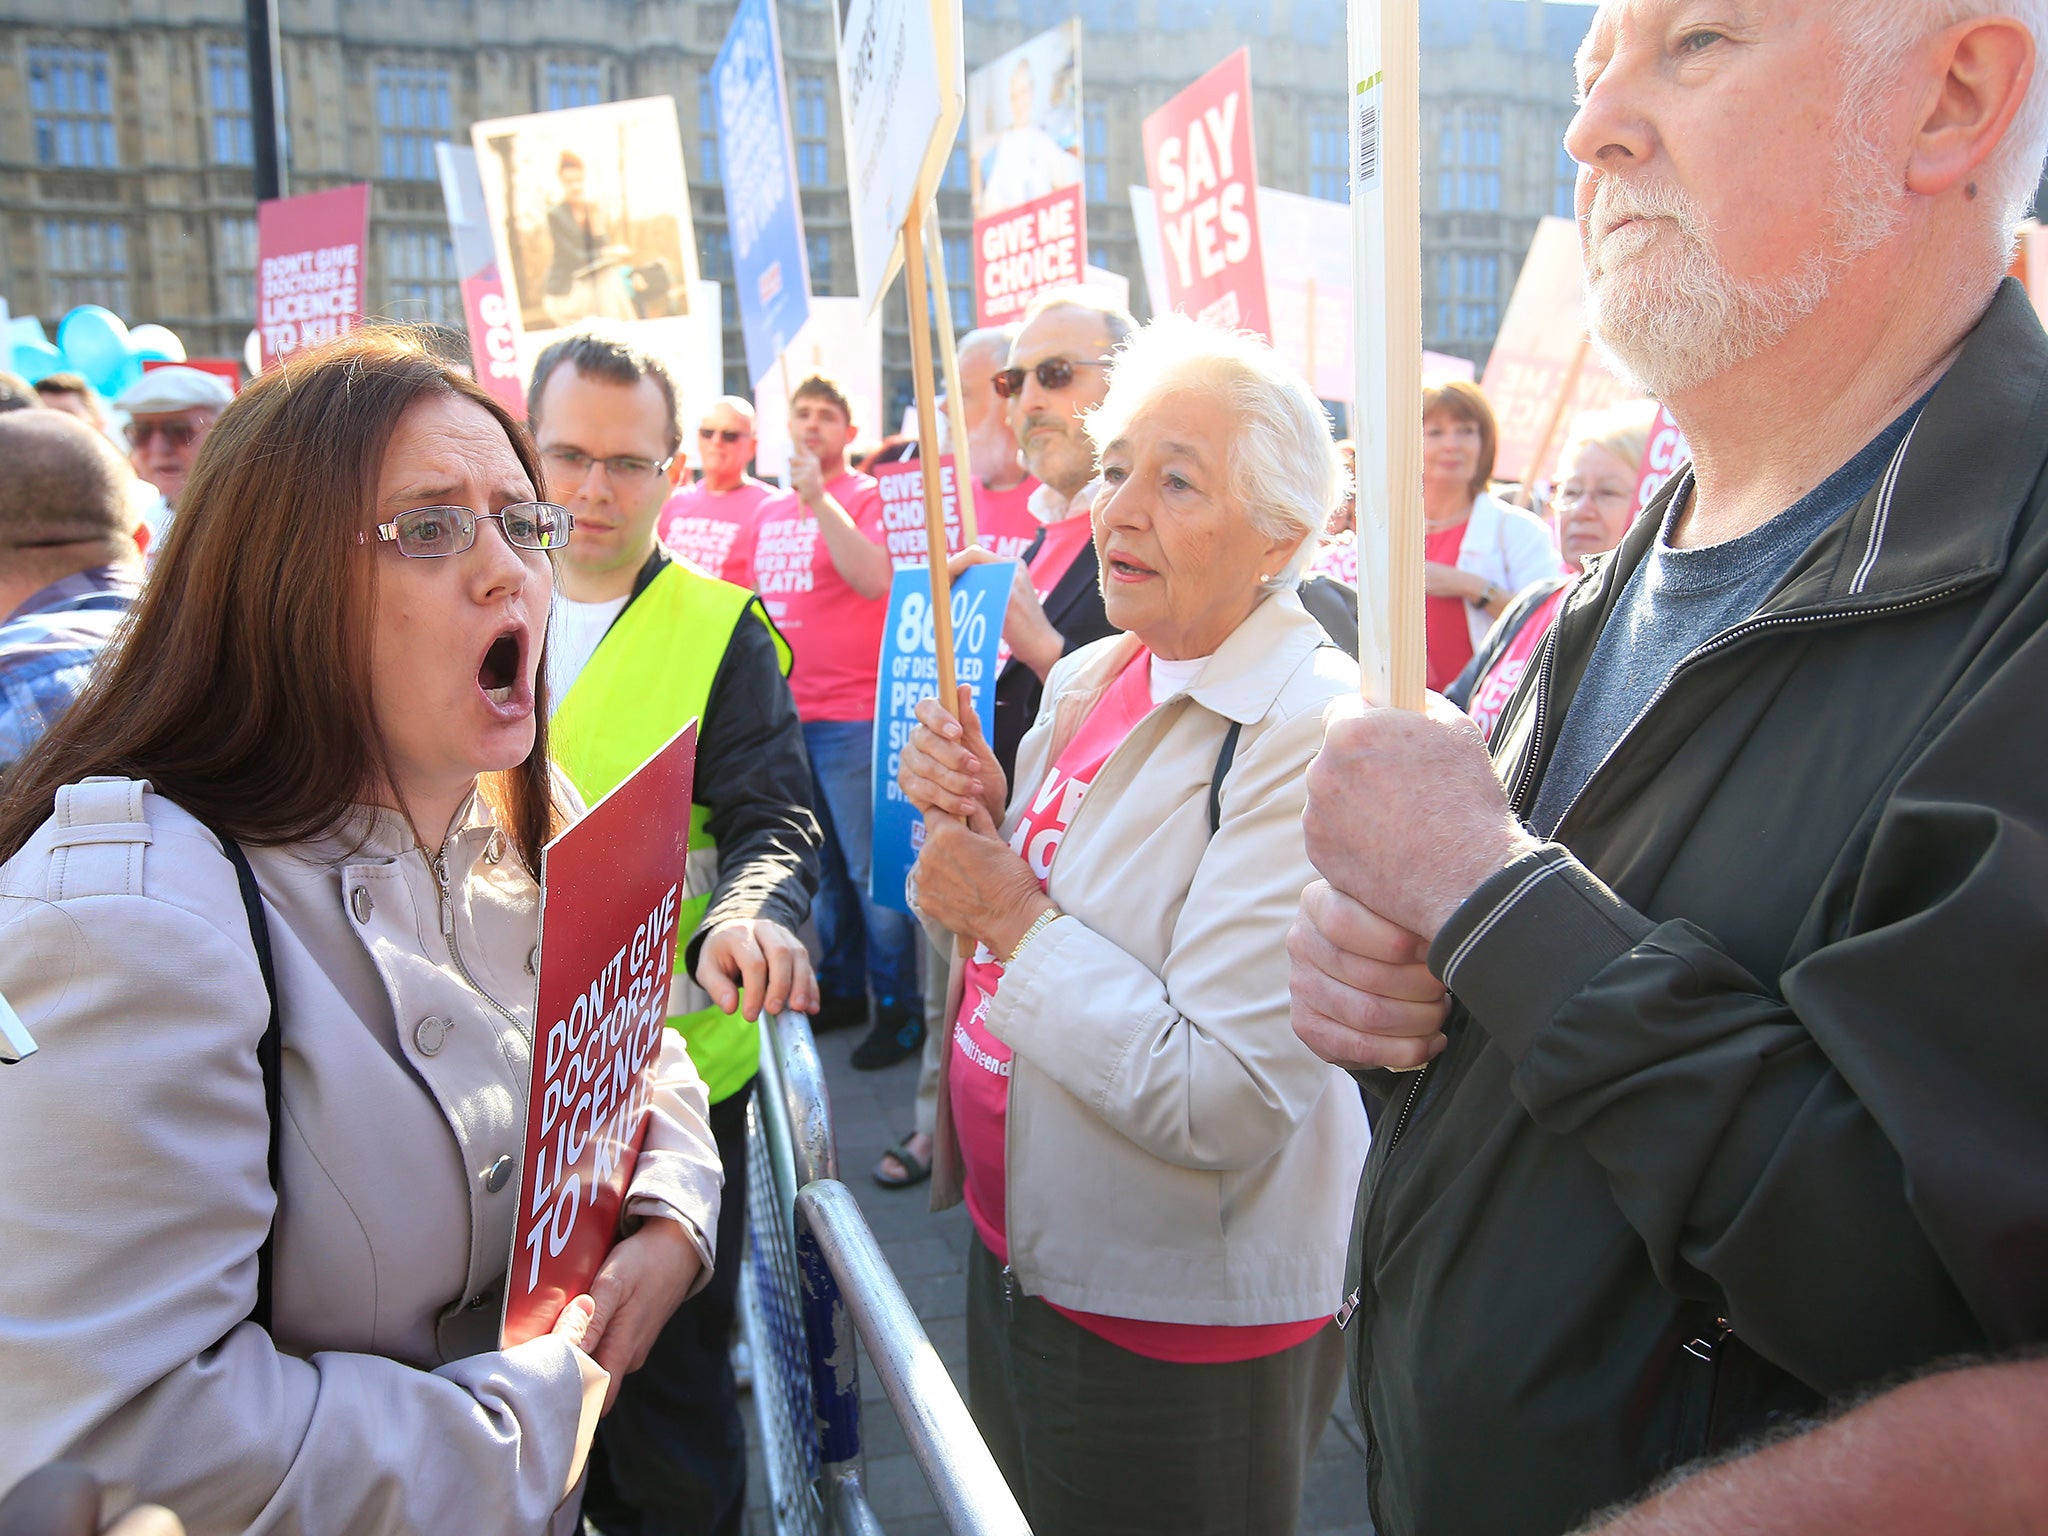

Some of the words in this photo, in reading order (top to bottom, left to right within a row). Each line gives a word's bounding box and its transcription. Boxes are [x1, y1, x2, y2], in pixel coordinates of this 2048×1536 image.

[1157, 90, 1239, 213] SAY
[982, 213, 1036, 261] GIVE
[1037, 199, 1075, 245] ME
[1164, 182, 1251, 288] YES
[315, 244, 358, 272] GIVE
[342, 267, 358, 286] A
[984, 236, 1076, 297] CHOICE
[262, 286, 358, 325] LICENCE
[262, 323, 298, 356] TO
[879, 471, 924, 501] GIVE
[882, 495, 960, 530] CHOE
[758, 570, 815, 594] EATH
[892, 656, 911, 678] OF
[911, 656, 983, 681] DISLED
[544, 943, 627, 1083] DON'T
[629, 882, 677, 976] GIVE
[540, 959, 654, 1140] DOCTORS
[655, 938, 668, 987] A
[531, 984, 665, 1219] LICENCE
[526, 1172, 581, 1295] TO
[590, 1060, 650, 1207] KILL
